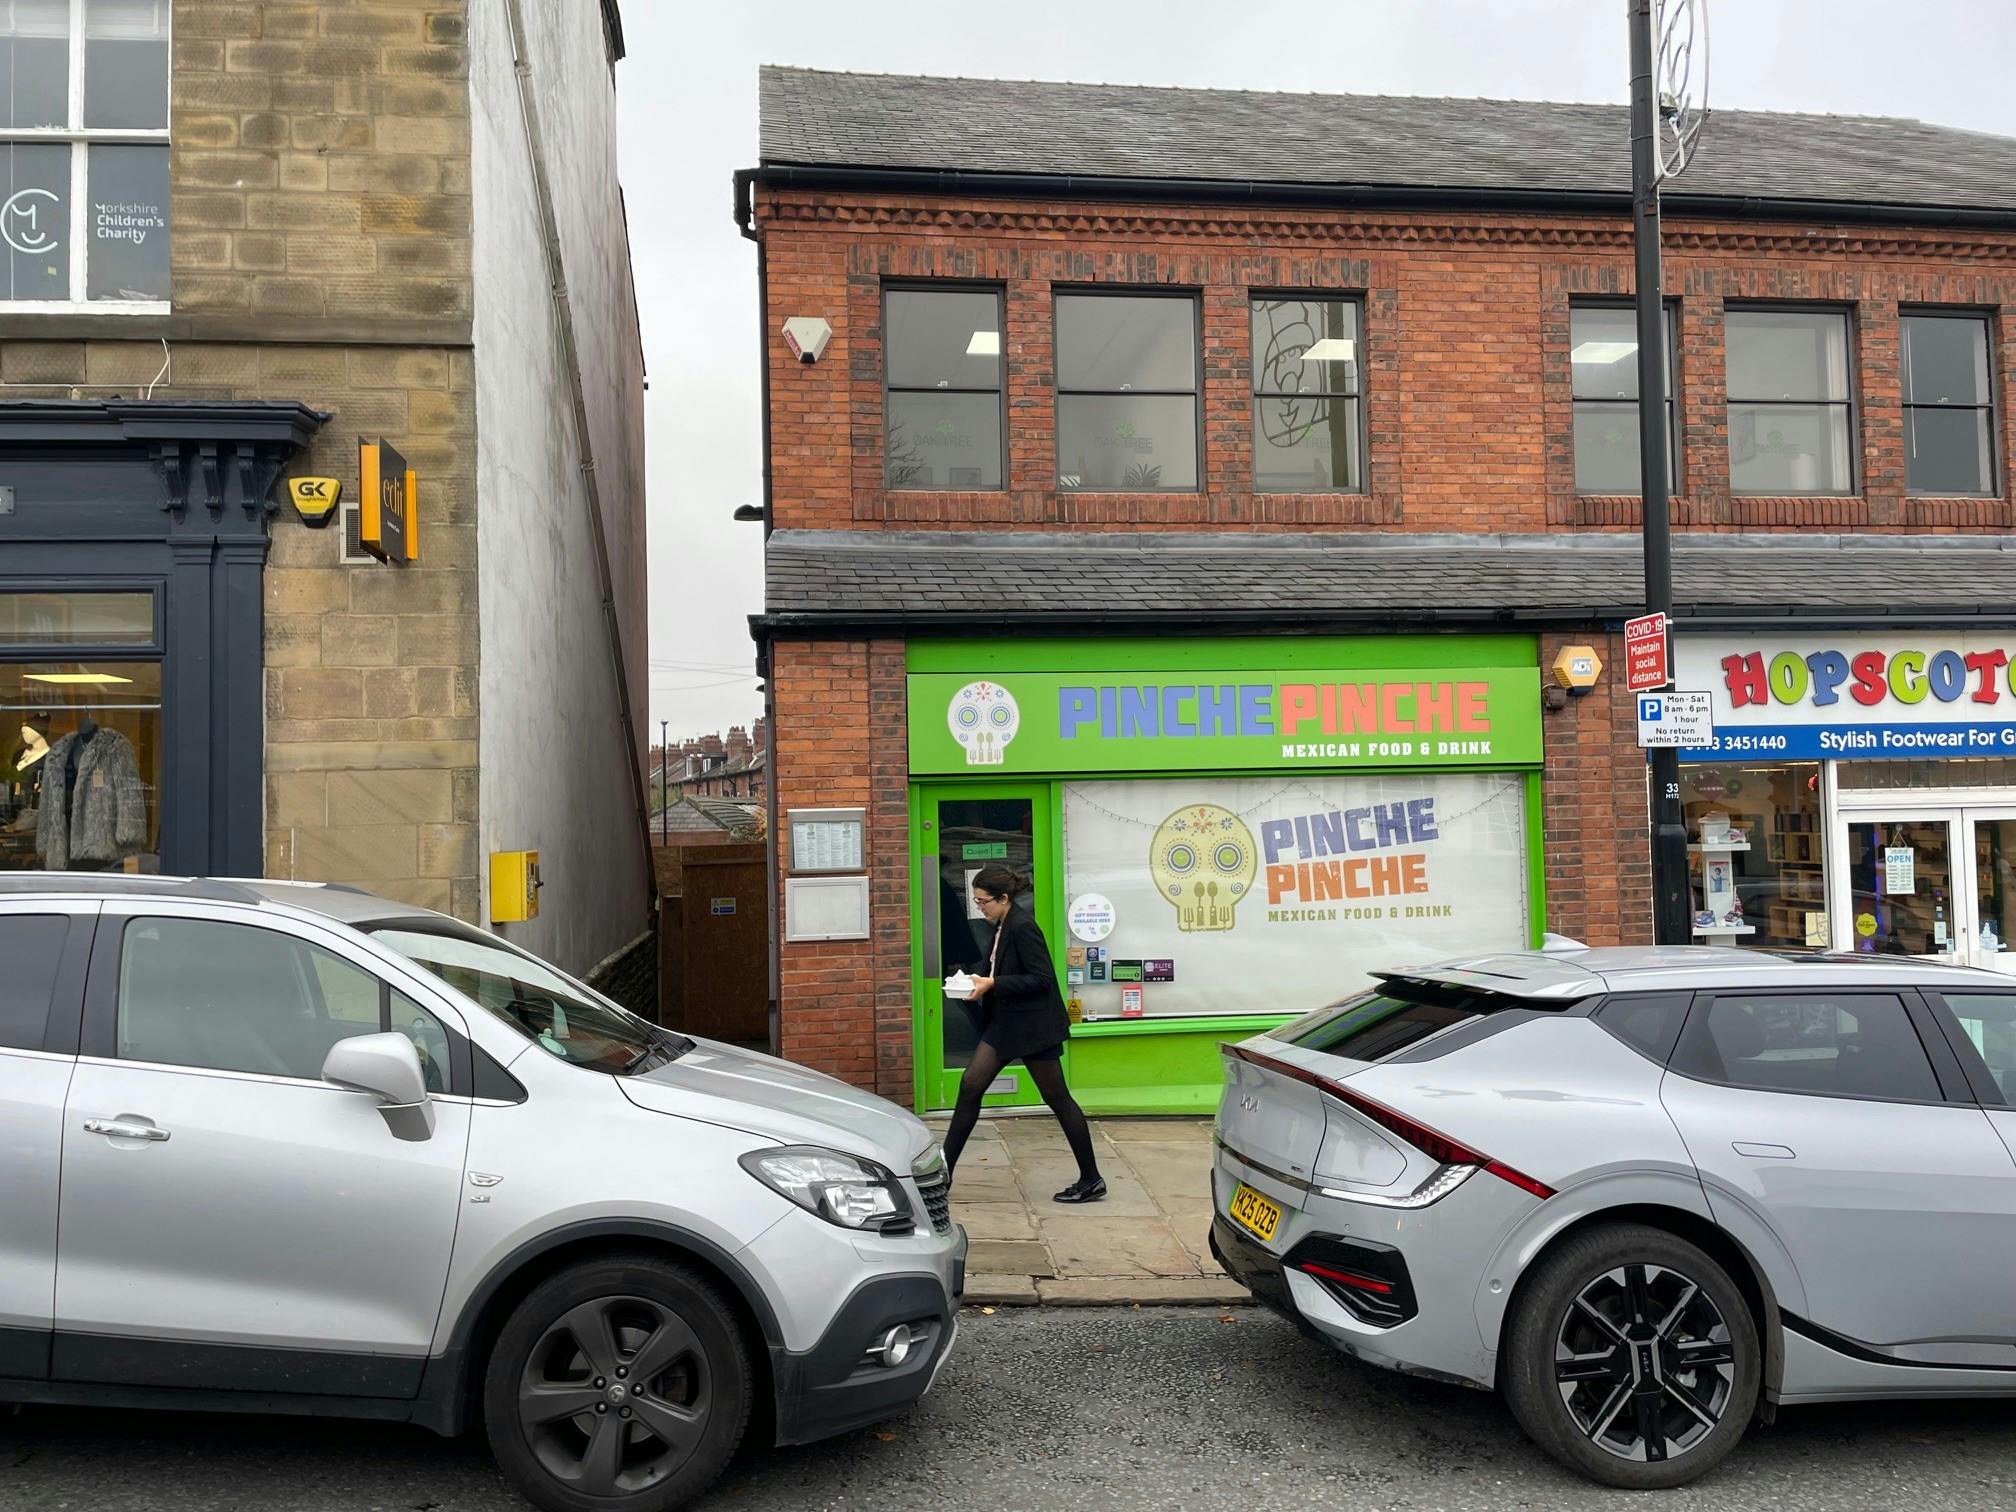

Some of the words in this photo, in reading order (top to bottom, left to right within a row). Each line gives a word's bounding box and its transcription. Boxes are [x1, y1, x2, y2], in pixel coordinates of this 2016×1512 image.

[95, 202, 158, 214] Yorkshire
[97, 214, 165, 227] Children's
[97, 227, 146, 244] Charity
[298, 481, 326, 497] GK
[383, 476, 403, 519] edit
[1630, 641, 1660, 656] Maintain
[1635, 656, 1657, 669] social
[1631, 670, 1661, 684] distance
[1721, 648, 2016, 709] HOPSCOT
[1667, 695, 1685, 703] Mon
[1690, 695, 1705, 703] Sat
[1059, 685, 1275, 739] PINCHE
[1280, 681, 1491, 736] PINCHE
[1724, 735, 1787, 750] 3451440
[1819, 731, 1877, 751] Stylish
[1883, 730, 1965, 748] Footwear
[1968, 729, 1996, 746] For
[2001, 728, 2016, 746] G
[1281, 743, 1360, 758] MEXICAN
[1368, 742, 1413, 757] FOOD
[1420, 742, 1430, 756] &
[1438, 741, 1492, 755] DRINK
[1666, 783, 1679, 793] 33
[1260, 797, 1439, 865] PINCHE
[1887, 854, 1912, 863] OPEN
[1266, 854, 1429, 905] PINCHE
[1268, 908, 1337, 923] MEXICAN
[1344, 907, 1383, 920] FOOD
[1390, 907, 1398, 918] &
[1405, 905, 1452, 918] DRINK
